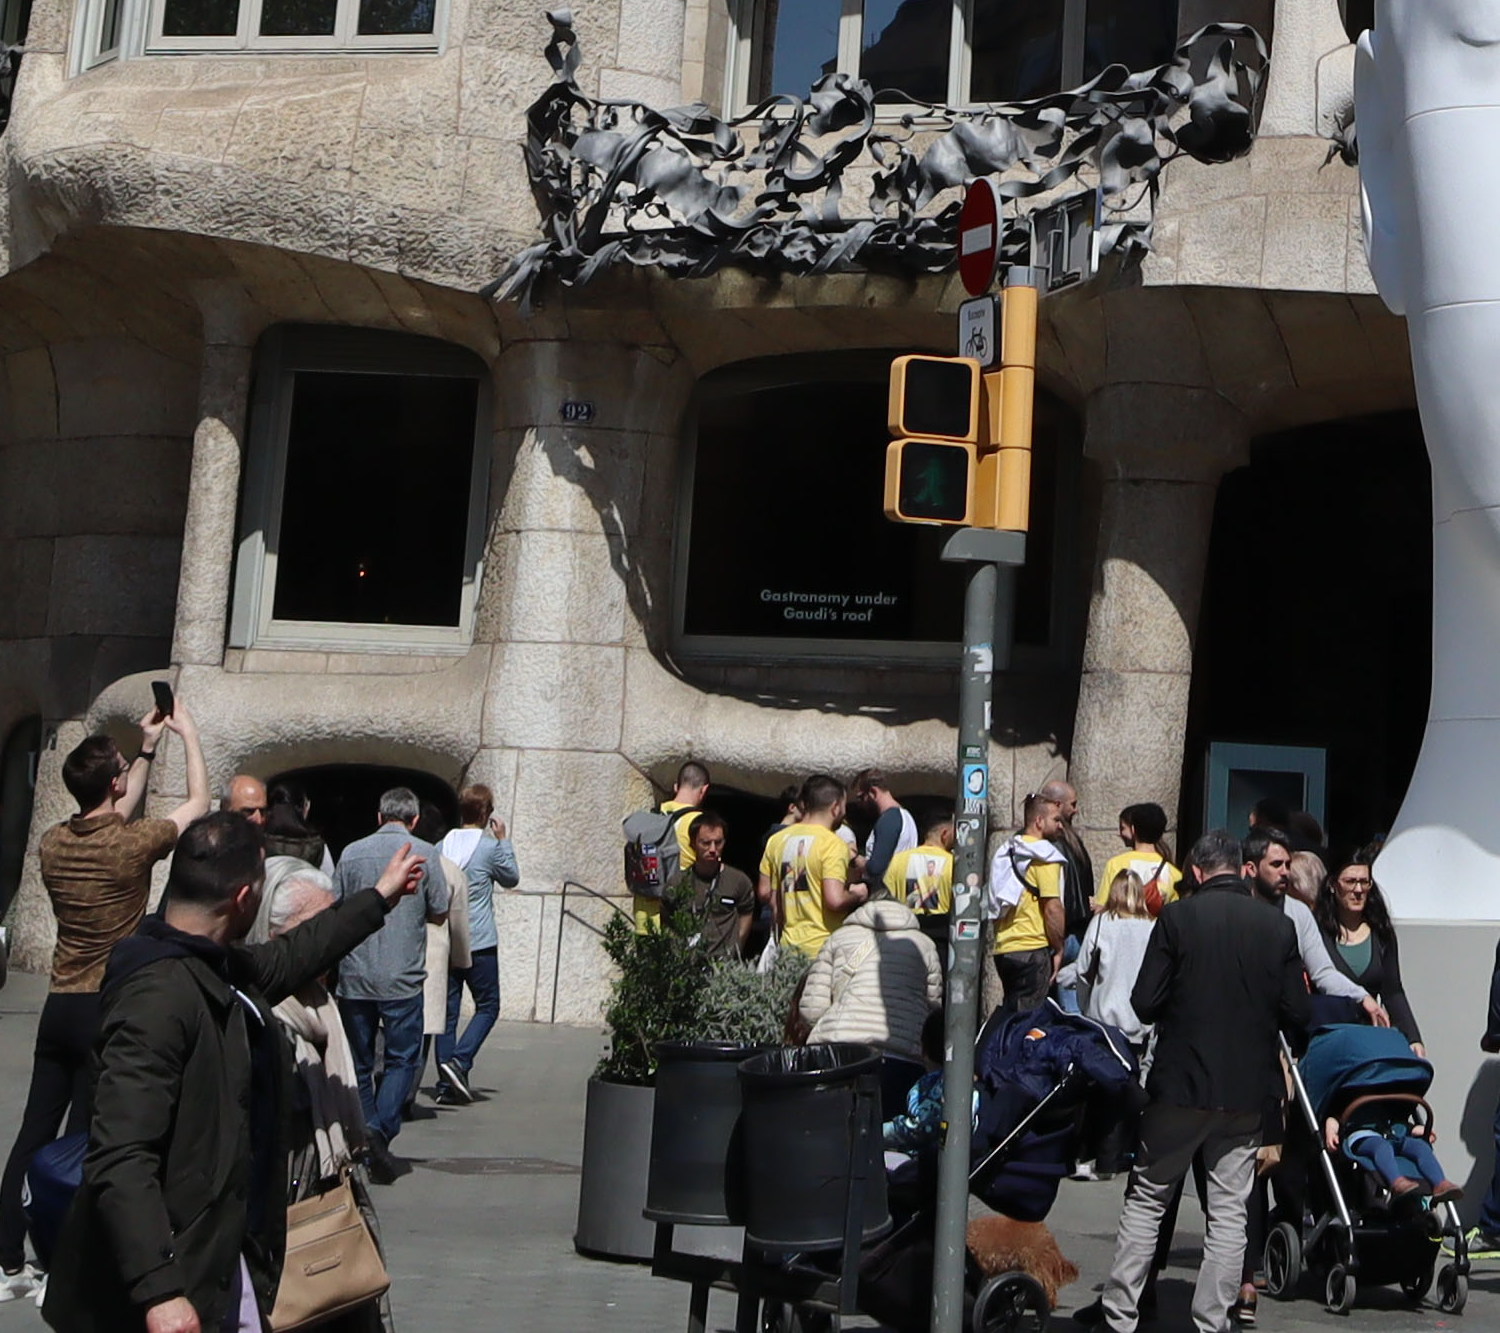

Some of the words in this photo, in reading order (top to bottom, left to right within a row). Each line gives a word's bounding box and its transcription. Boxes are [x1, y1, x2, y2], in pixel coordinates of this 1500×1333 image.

[566, 404, 588, 420] 92
[759, 588, 850, 607] Gastronomy
[854, 591, 898, 606] under
[841, 608, 874, 622] roof
